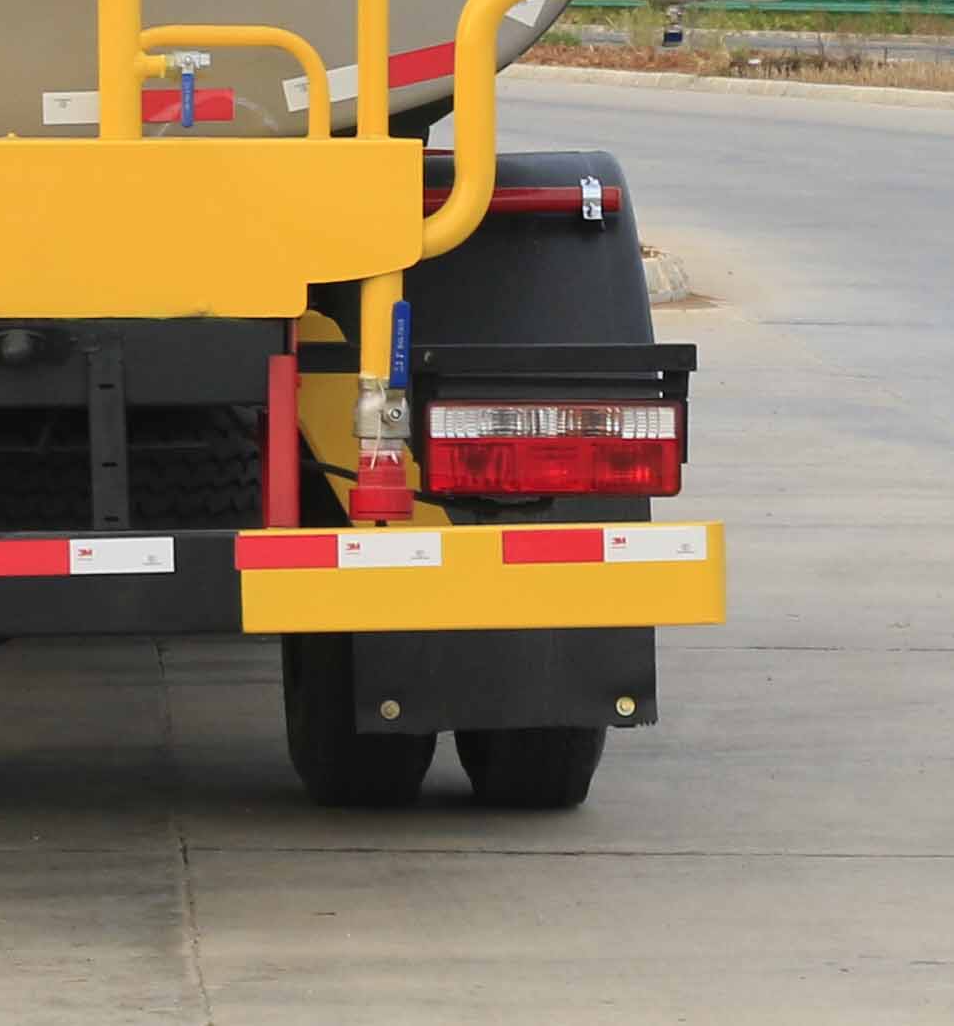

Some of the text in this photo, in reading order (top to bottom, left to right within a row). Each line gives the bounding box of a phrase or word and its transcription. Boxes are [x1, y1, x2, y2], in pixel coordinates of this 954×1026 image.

[611, 537, 627, 546] 3M
[346, 542, 361, 552] 3M
[78, 549, 93, 557] 3M
